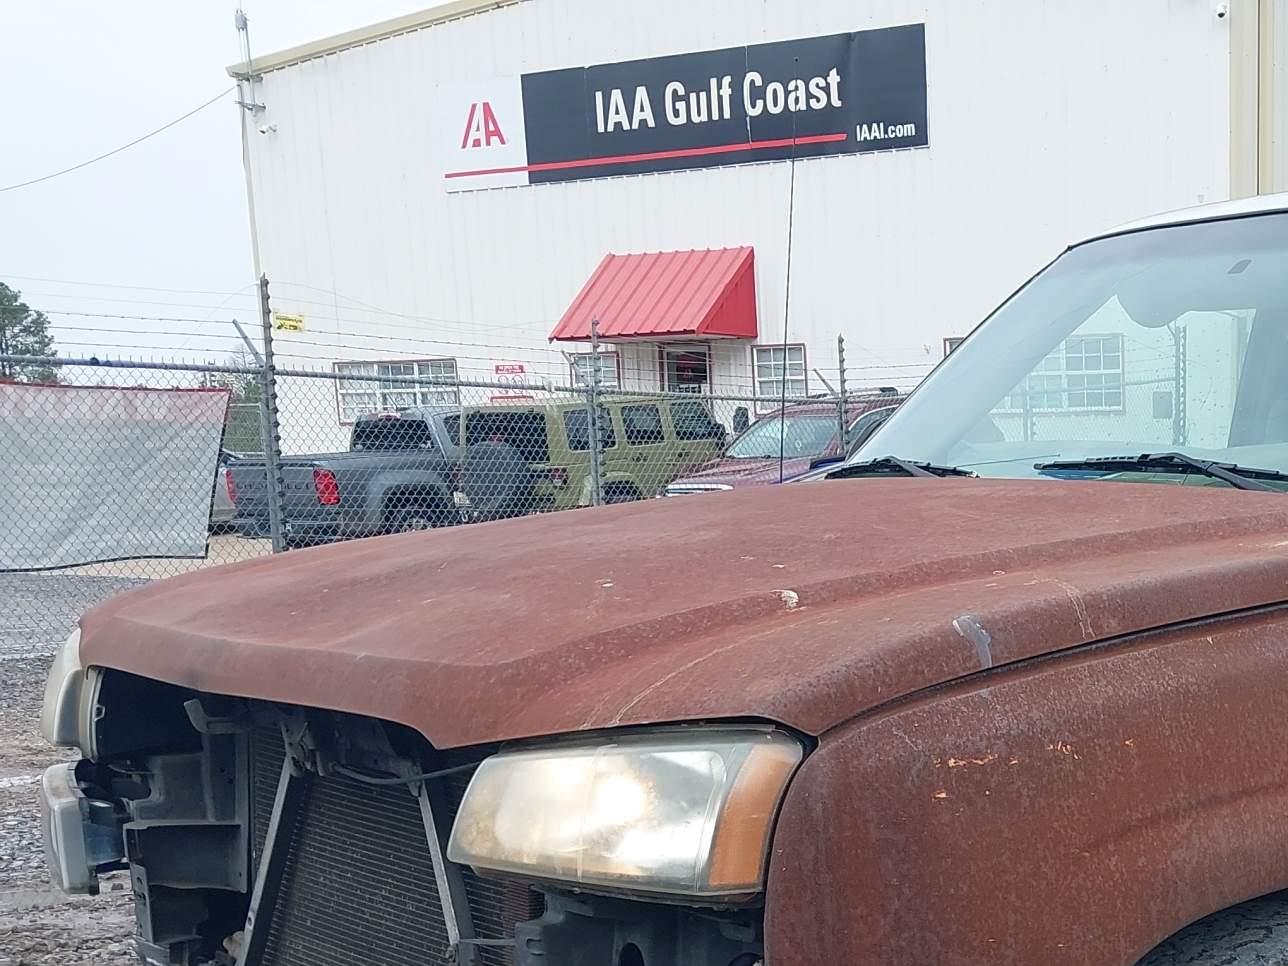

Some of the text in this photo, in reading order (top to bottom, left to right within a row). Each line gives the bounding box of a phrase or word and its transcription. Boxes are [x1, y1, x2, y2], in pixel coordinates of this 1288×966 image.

[595, 67, 842, 133] IAA Gulf Coast
[856, 122, 916, 142] IAAI.com
